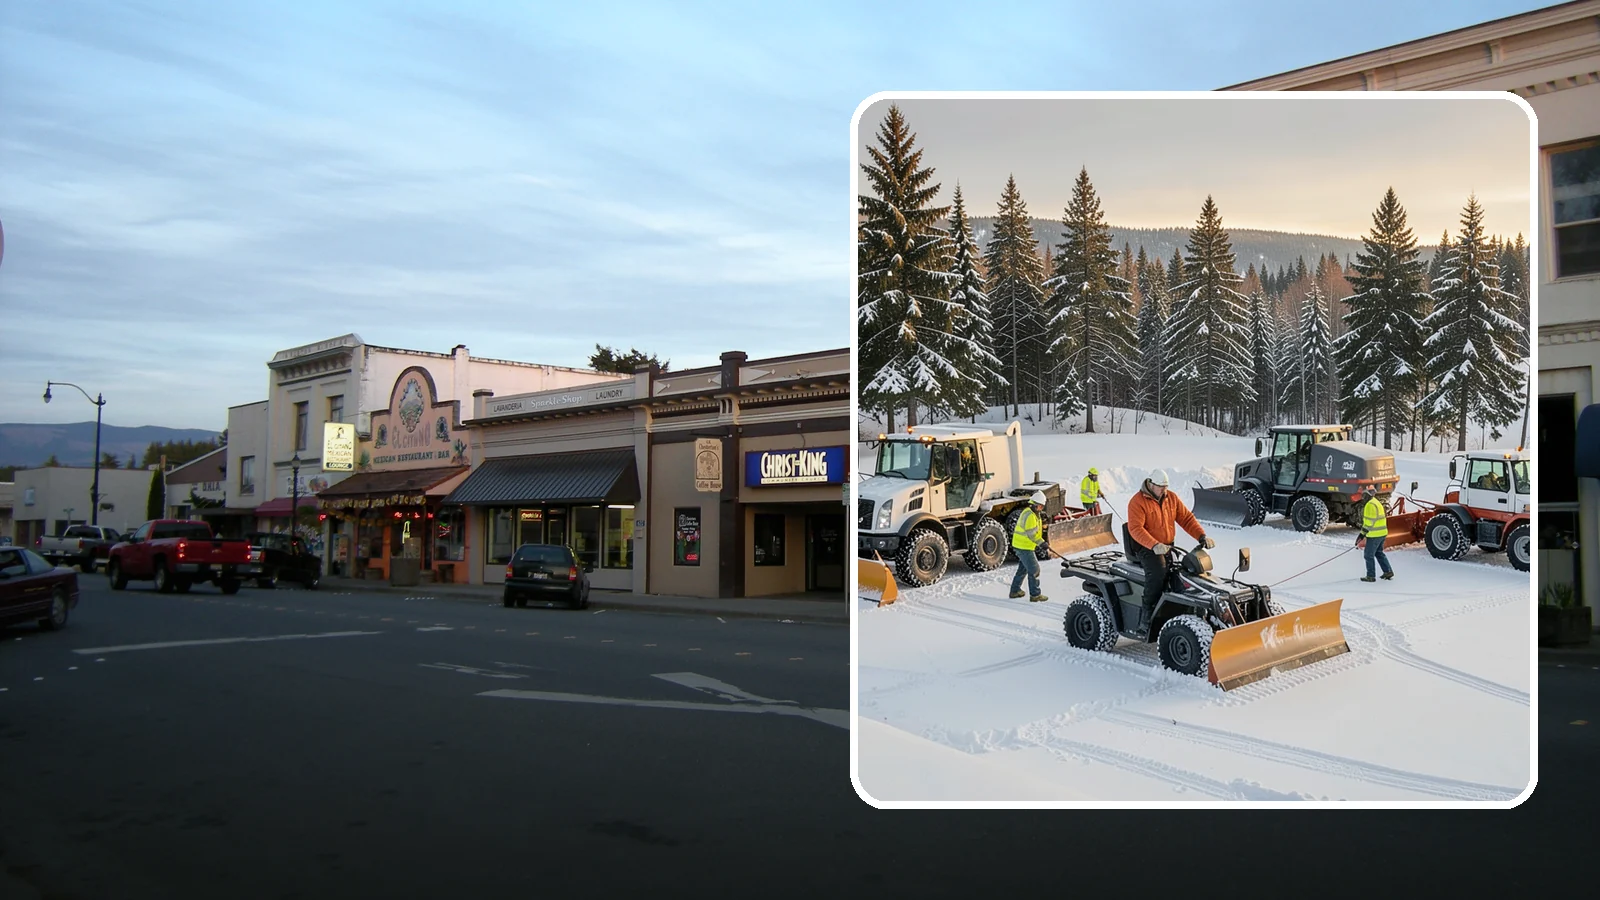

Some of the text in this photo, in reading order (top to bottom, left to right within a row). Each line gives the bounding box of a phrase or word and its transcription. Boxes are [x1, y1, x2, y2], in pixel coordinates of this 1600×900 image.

[493, 389, 623, 412] LAVANDERIA Sparkle Shop LAUNDRY
[373, 455, 396, 464] MEXICAN
[397, 451, 434, 463] RESTAURANT
[438, 450, 450, 459] BAR
[761, 450, 828, 478] CHRIST KING
